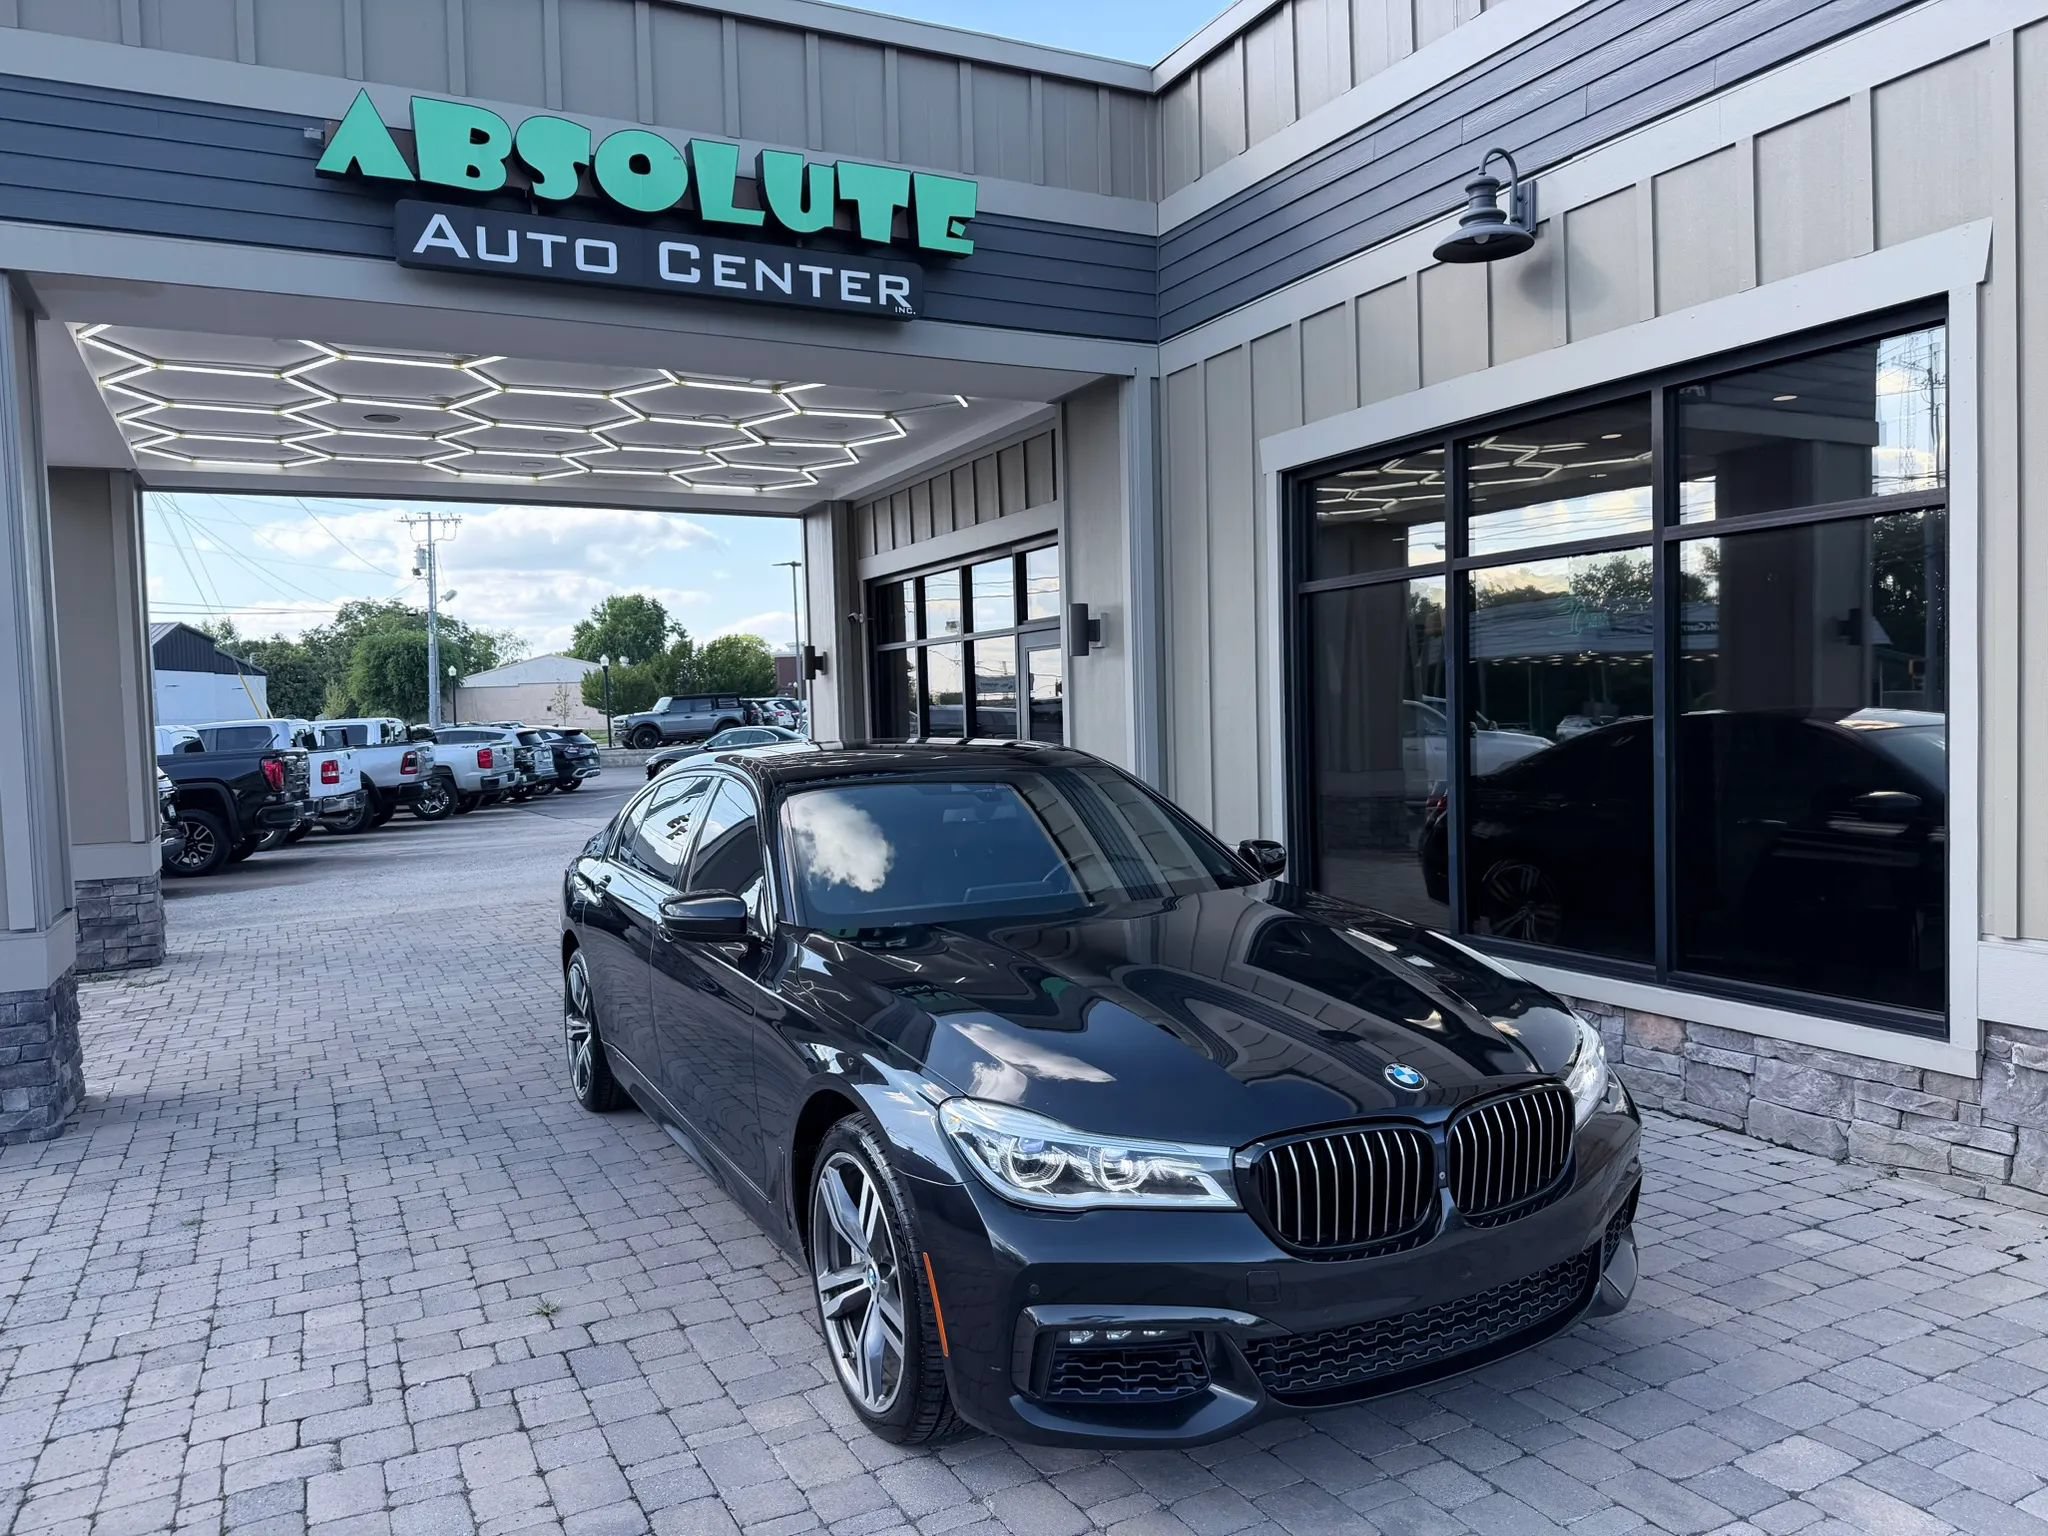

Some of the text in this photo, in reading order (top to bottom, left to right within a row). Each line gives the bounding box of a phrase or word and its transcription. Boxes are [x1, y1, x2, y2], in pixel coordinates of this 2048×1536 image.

[315, 87, 979, 257] ABSOLUTE
[412, 213, 912, 308] AUTO CENTER
[894, 306, 917, 316] INC.
